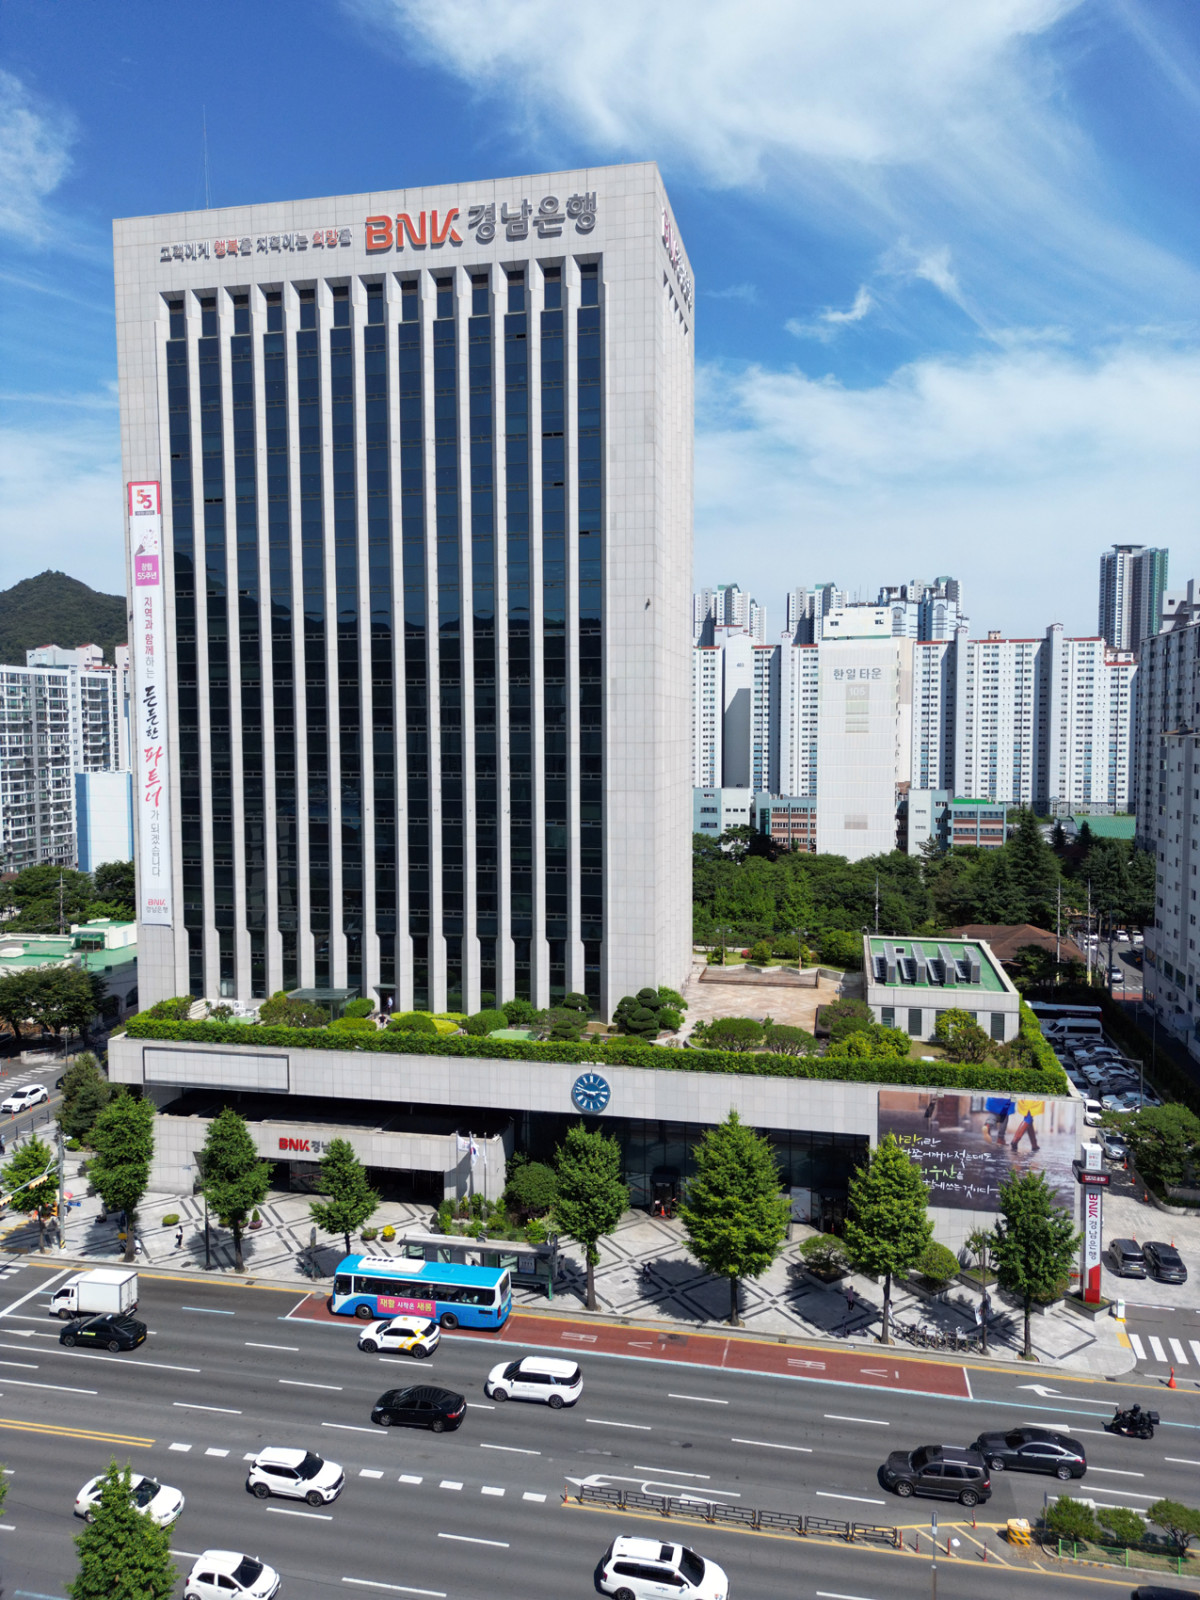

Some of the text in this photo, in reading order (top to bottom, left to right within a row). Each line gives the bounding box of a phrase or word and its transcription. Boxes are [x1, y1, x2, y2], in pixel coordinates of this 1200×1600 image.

[366, 191, 598, 252] BNK 경남은행
[160, 227, 352, 262] 고객에게 행복을 지역에는 희망을
[136, 489, 153, 510] 55
[144, 597, 152, 630] 지역과
[145, 634, 155, 679] 함께하는
[143, 685, 159, 740] 든든한
[150, 822, 160, 877] 되겠습니다
[146, 906, 168, 914] 경남은행
[147, 898, 166, 906] BNK
[279, 1137, 310, 1152] BNK
[1088, 1193, 1099, 1218] BNK
[1089, 1220, 1098, 1260] 경남은행
